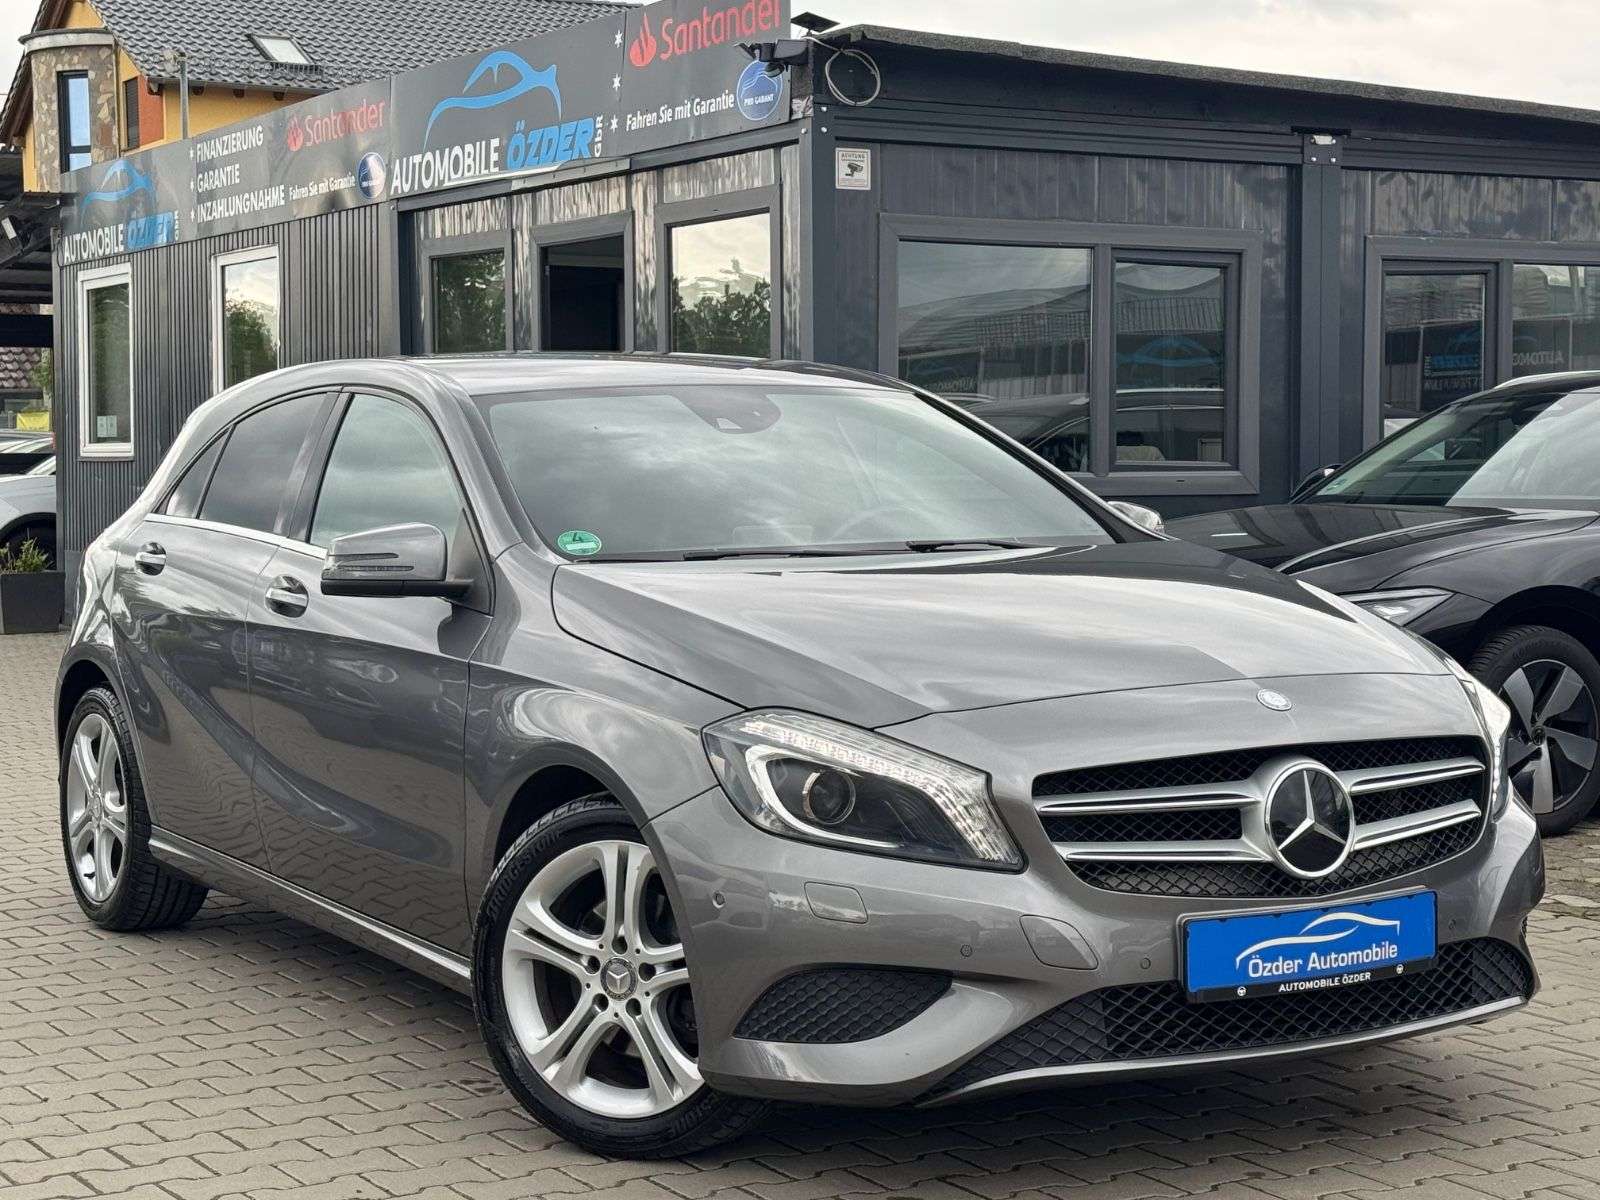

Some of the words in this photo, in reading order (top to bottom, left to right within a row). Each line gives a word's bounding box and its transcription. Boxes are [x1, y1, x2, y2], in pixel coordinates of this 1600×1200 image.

[626, 110, 657, 132] Fahren
[658, 103, 673, 124] Sie
[674, 99, 691, 120] mit
[693, 89, 735, 116] Garantie
[196, 125, 264, 163] FINANZIERUNG
[390, 137, 500, 196] AUTOMOBILE
[506, 119, 595, 172] ÖZDER
[197, 163, 240, 193] GARANTIE
[289, 184, 309, 201] Fahren
[308, 180, 318, 197] Sie
[197, 184, 285, 223] INZAHLUNGNAHME
[63, 223, 125, 264] AUTOMOBILE
[1249, 955, 1302, 978] Özder
[1307, 941, 1398, 971] Automobile
[1342, 971, 1371, 984] ÖZDER
